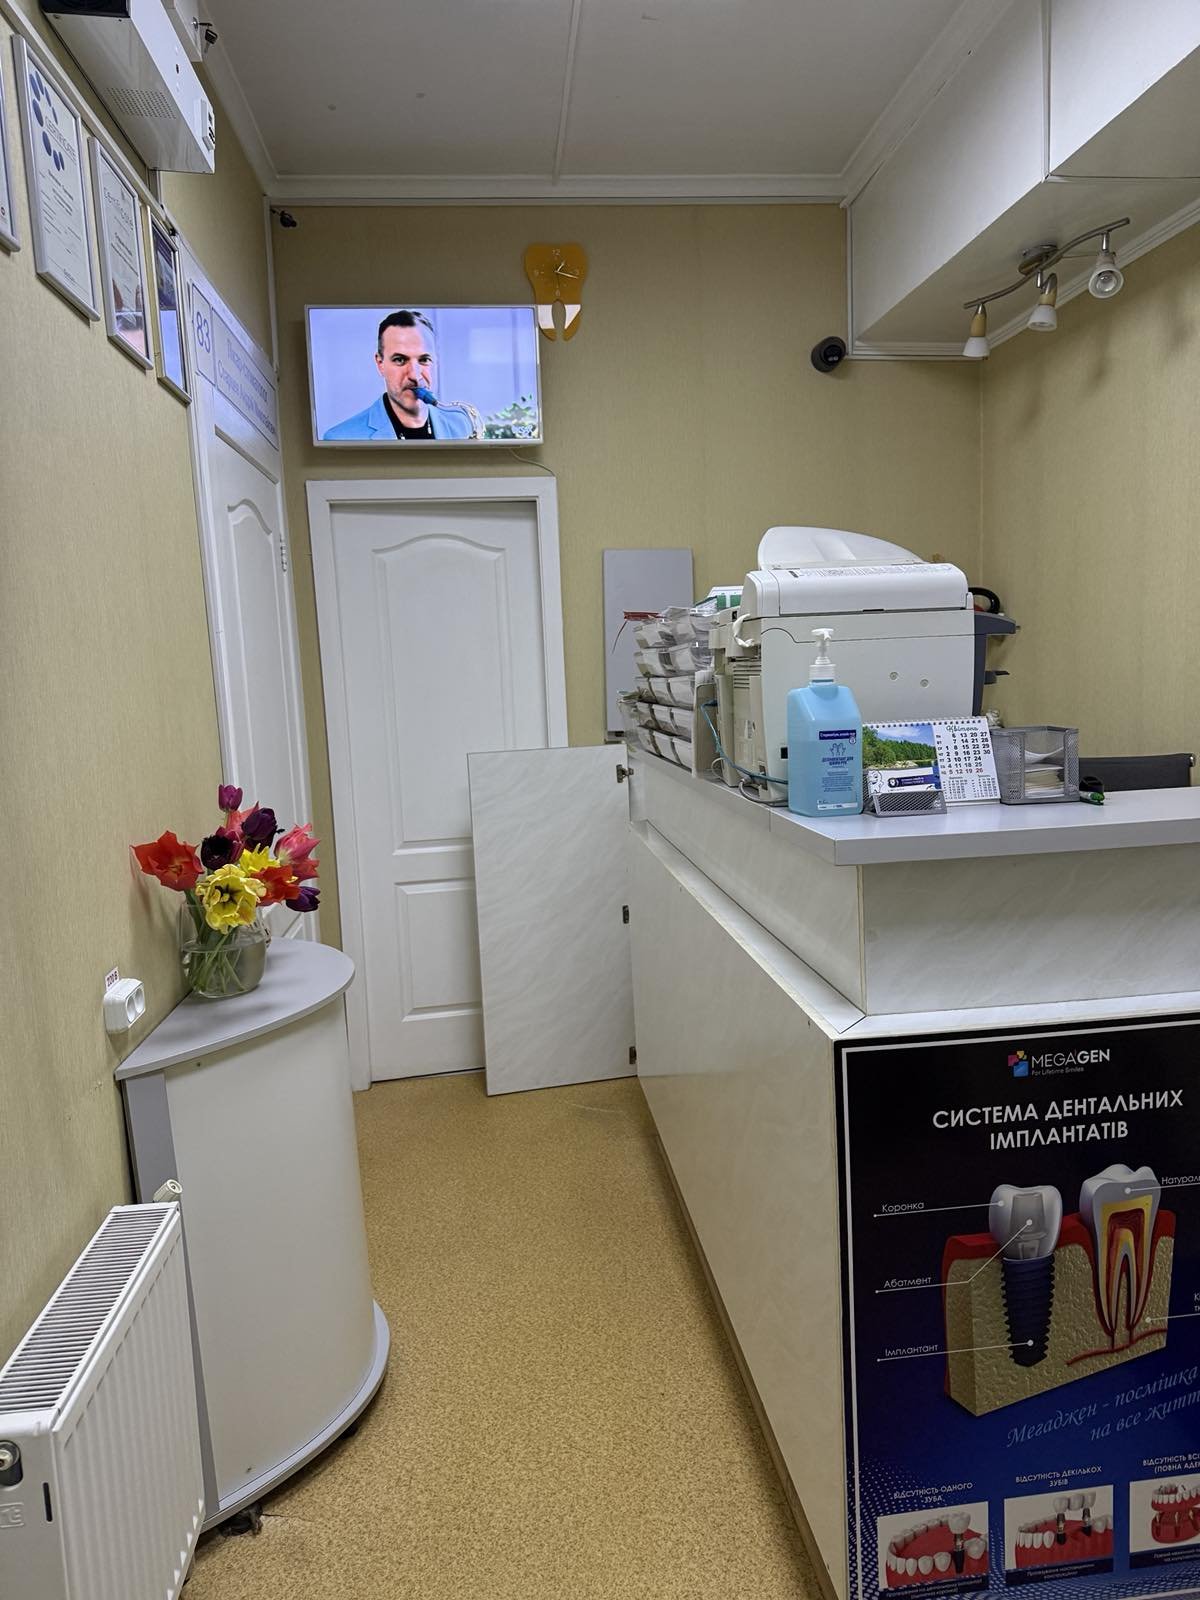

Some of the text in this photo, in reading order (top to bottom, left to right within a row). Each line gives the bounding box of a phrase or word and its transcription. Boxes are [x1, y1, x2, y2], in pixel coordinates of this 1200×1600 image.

[196, 311, 210, 353] 83
[932, 1088, 1184, 1128] СИСТЕМА ДЕНТАЛЬНИХ
[990, 1120, 1128, 1150] ІМПЛАНТАТІВ
[1161, 1175, 1200, 1185] Натурал
[882, 1202, 924, 1213] Коронка
[884, 1276, 932, 1288] Абатмент
[885, 1344, 938, 1356] Імплантант
[1006, 1403, 1097, 1448] Мегаджен
[1114, 1366, 1198, 1407] посмішка
[1090, 1424, 1112, 1441] на
[1116, 1412, 1141, 1432] все
[1143, 1455, 1186, 1466] ВІДСУТНІСТЬ
[1016, 1466, 1102, 1483] ВІДСУТНІСТЬ ДЕКІЛЬКОХ
[1154, 1464, 1181, 1474] (ПОВНА
[1049, 1479, 1068, 1487] ЗУБІВ
[893, 1482, 973, 1499] ВІДСУТНІСТЬ ОДНОГО
